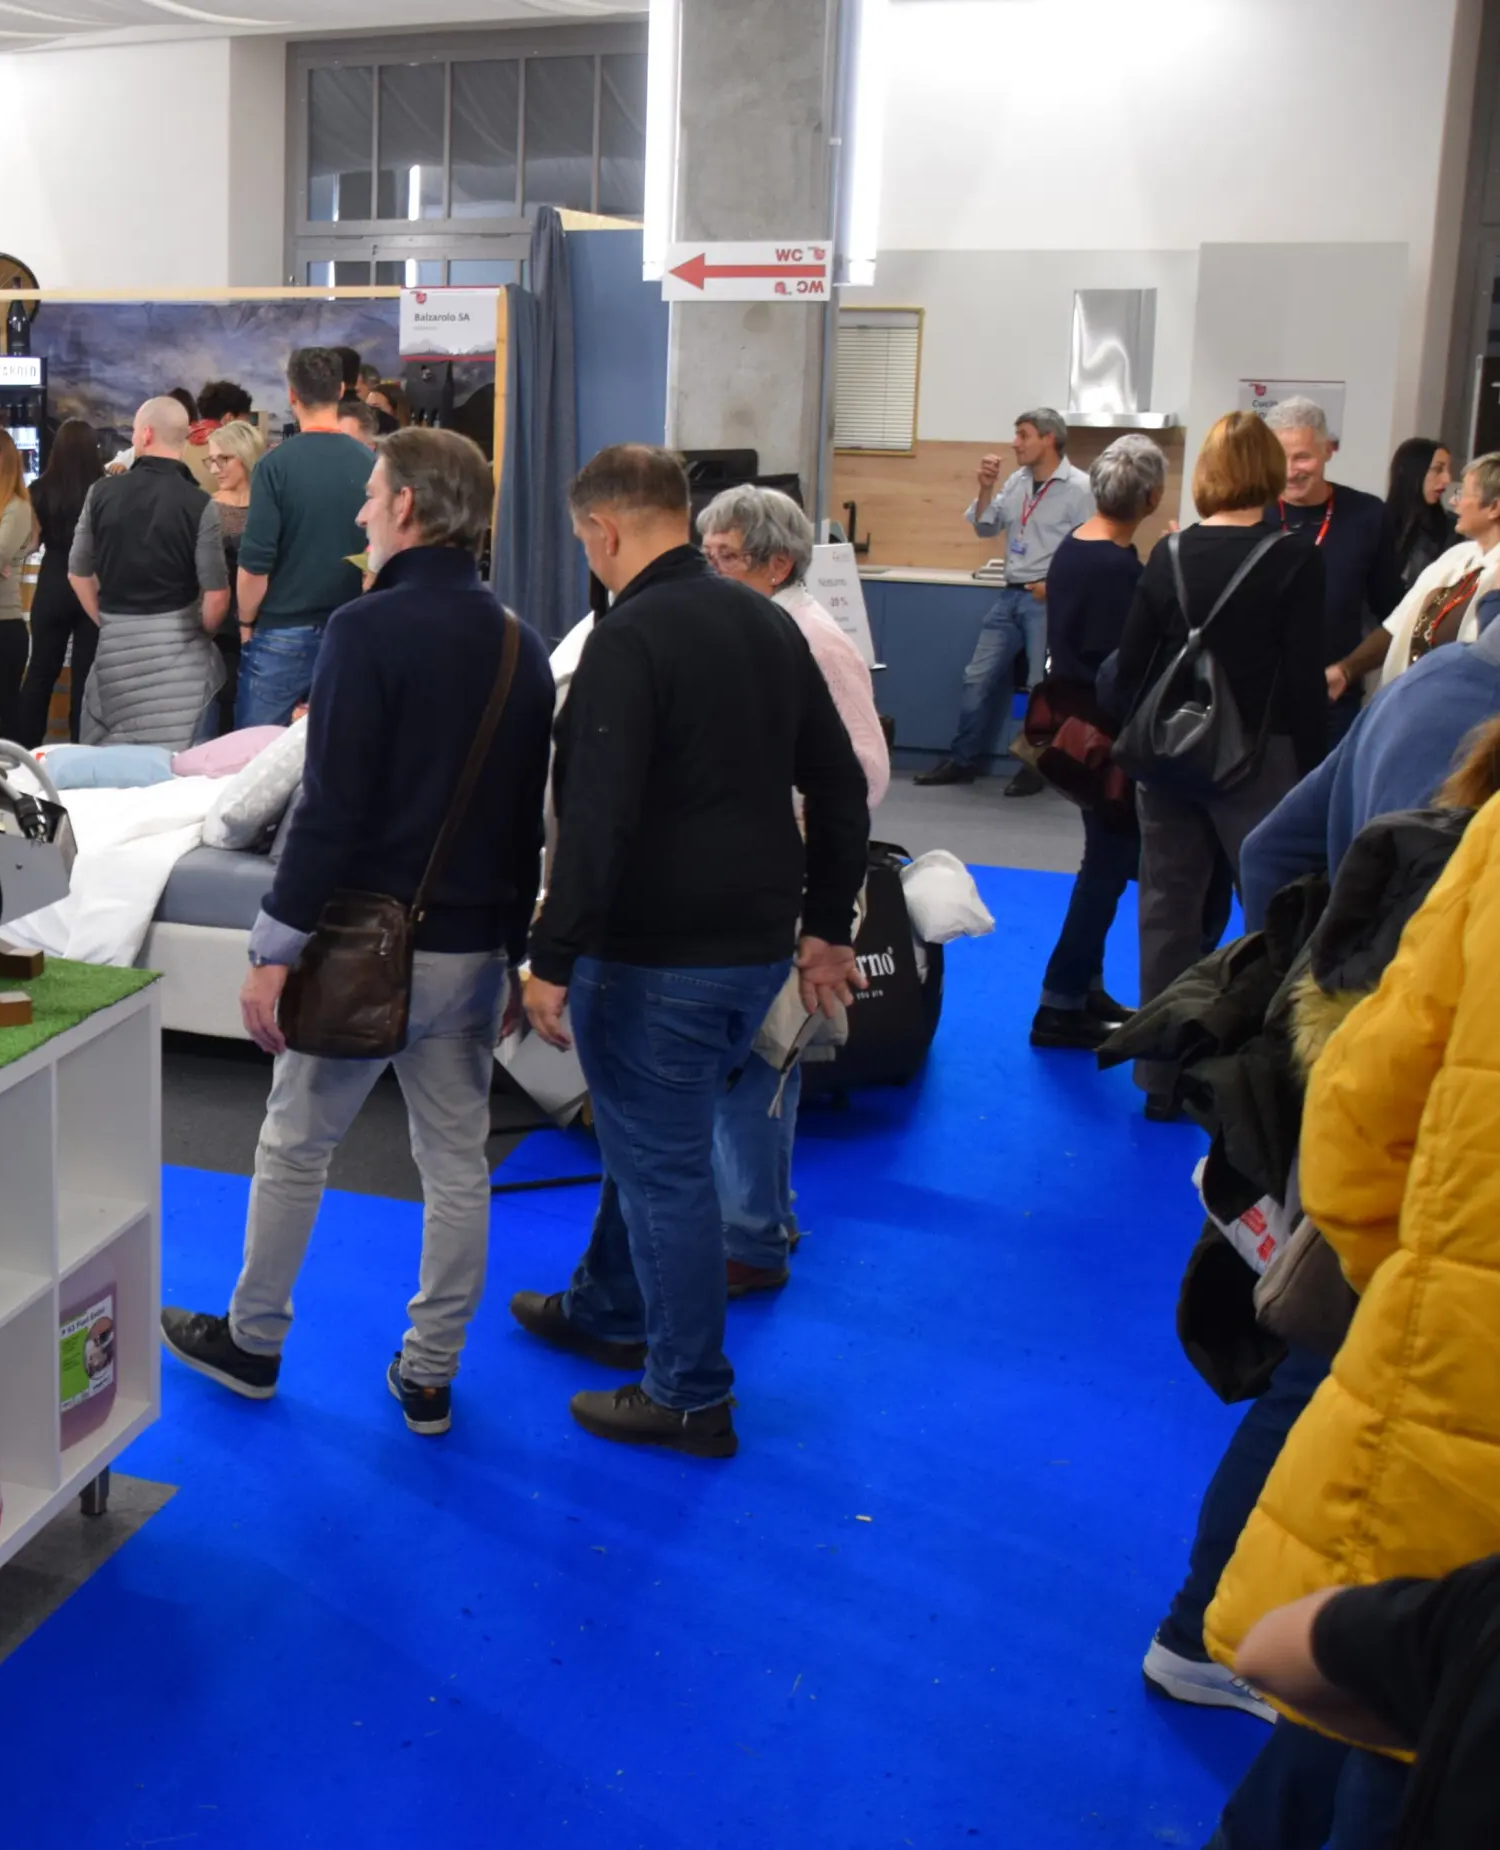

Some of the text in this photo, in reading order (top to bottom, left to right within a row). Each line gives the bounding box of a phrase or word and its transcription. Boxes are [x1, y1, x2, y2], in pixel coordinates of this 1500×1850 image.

[775, 249, 803, 262] WC
[797, 281, 824, 293] WC
[414, 313, 470, 322] Balzarolo SA
